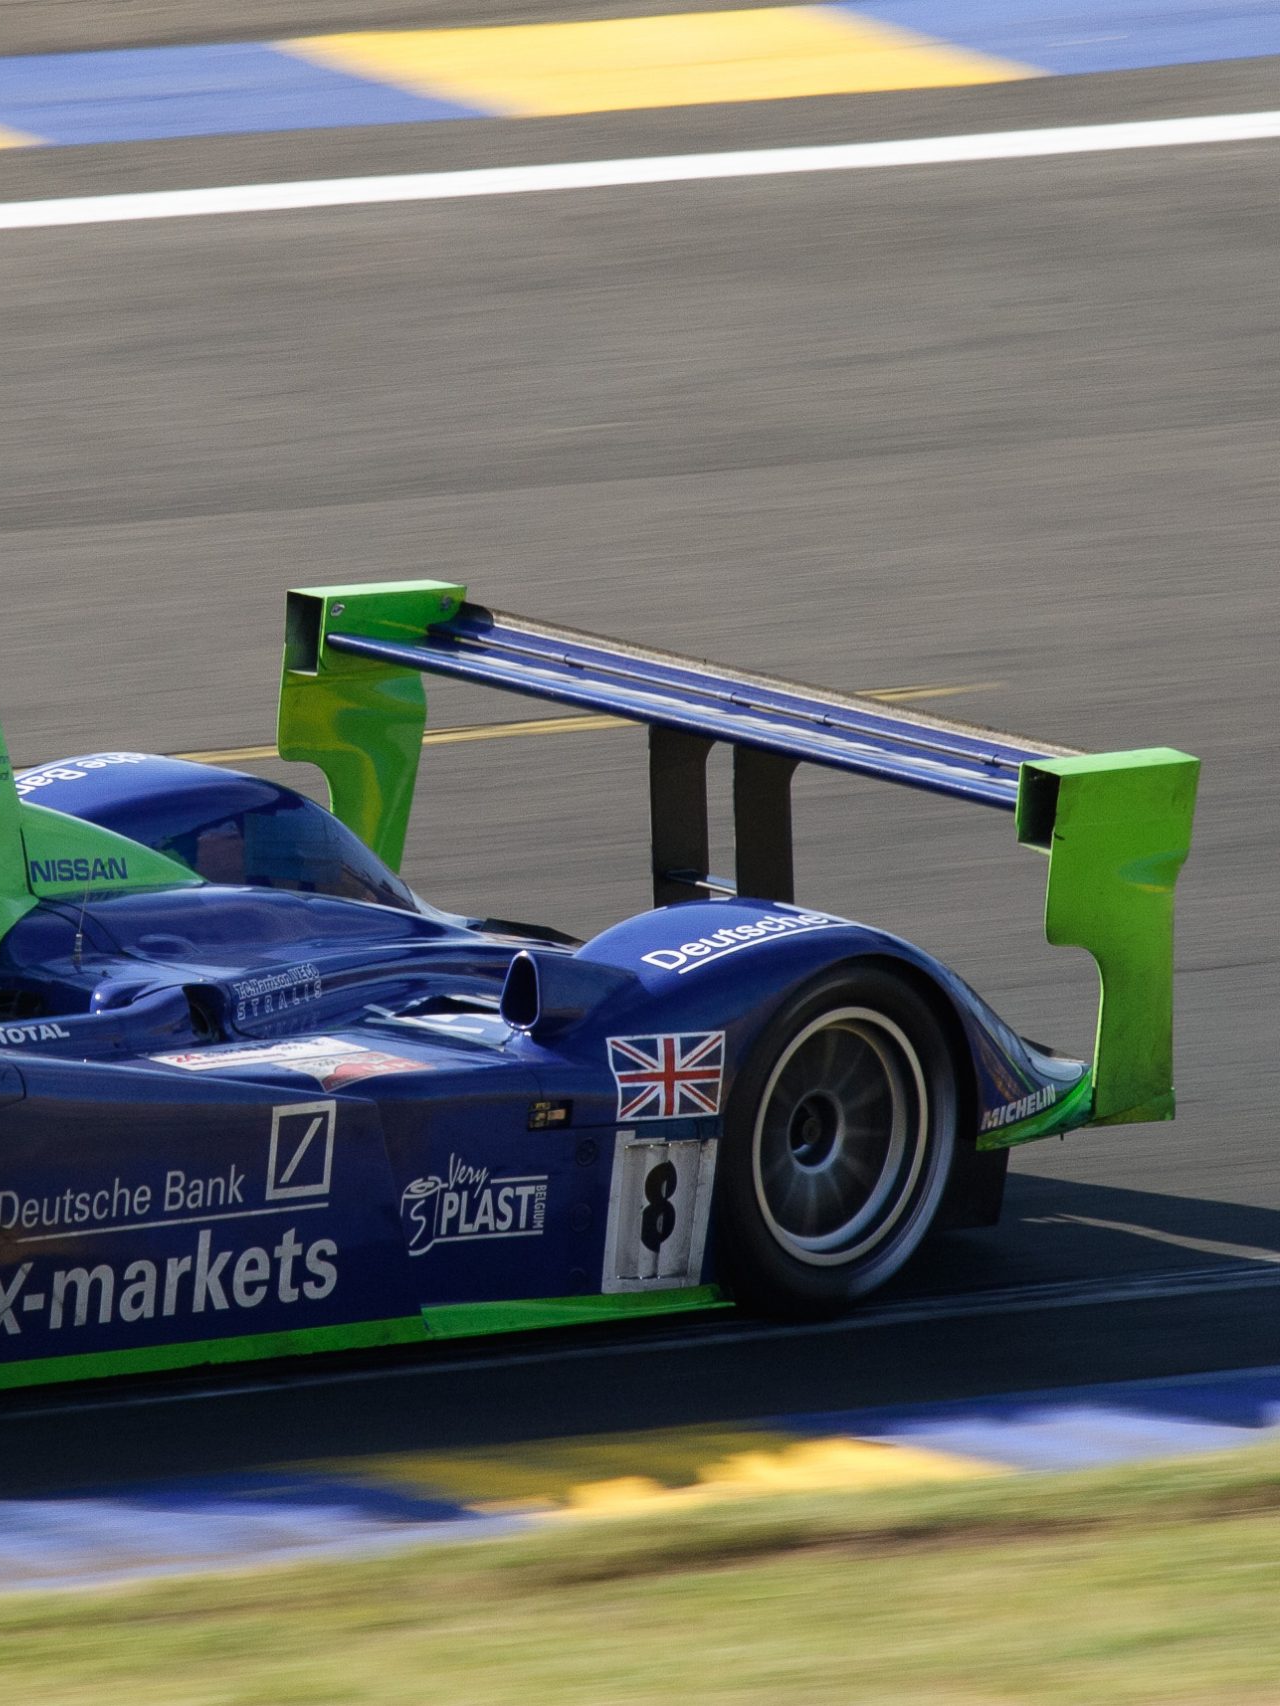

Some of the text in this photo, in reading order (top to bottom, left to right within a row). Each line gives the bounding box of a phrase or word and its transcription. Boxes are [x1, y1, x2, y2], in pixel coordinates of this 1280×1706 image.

[30, 856, 129, 884] NISSAN
[640, 912, 831, 971] Deutsche
[979, 1083, 1057, 1131] MICHELIN
[163, 1164, 246, 1212] Bank
[448, 1152, 490, 1199] Very
[440, 1185, 536, 1236] PLAST
[532, 1184, 547, 1229] BELGIUM
[641, 1160, 677, 1252] 8
